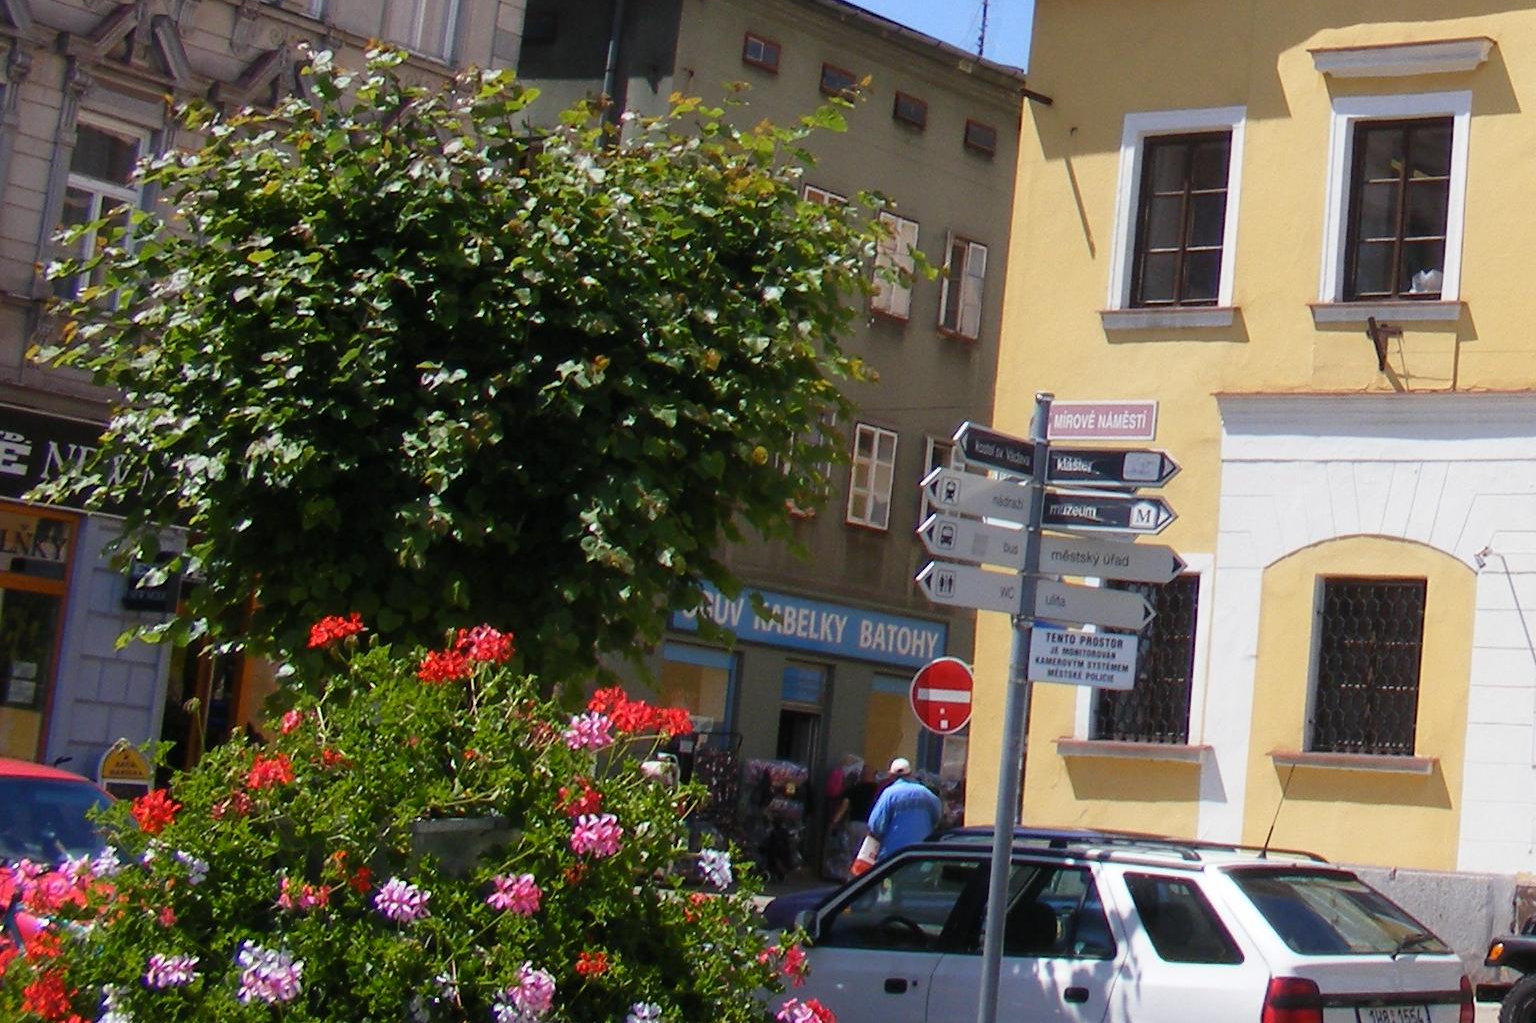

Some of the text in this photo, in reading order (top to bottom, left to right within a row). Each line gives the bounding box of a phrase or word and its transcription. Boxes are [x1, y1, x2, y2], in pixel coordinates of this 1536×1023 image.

[1054, 410, 1148, 430] MÍROVÉ NÁMĚSTÍ
[1003, 541, 1019, 556] bus
[1051, 549, 1130, 567] městský úřad
[1000, 585, 1015, 598] WC
[859, 618, 940, 659] BATOHY
[1046, 631, 1124, 650] TENTO PROSTOR
[1050, 645, 1059, 655] JE
